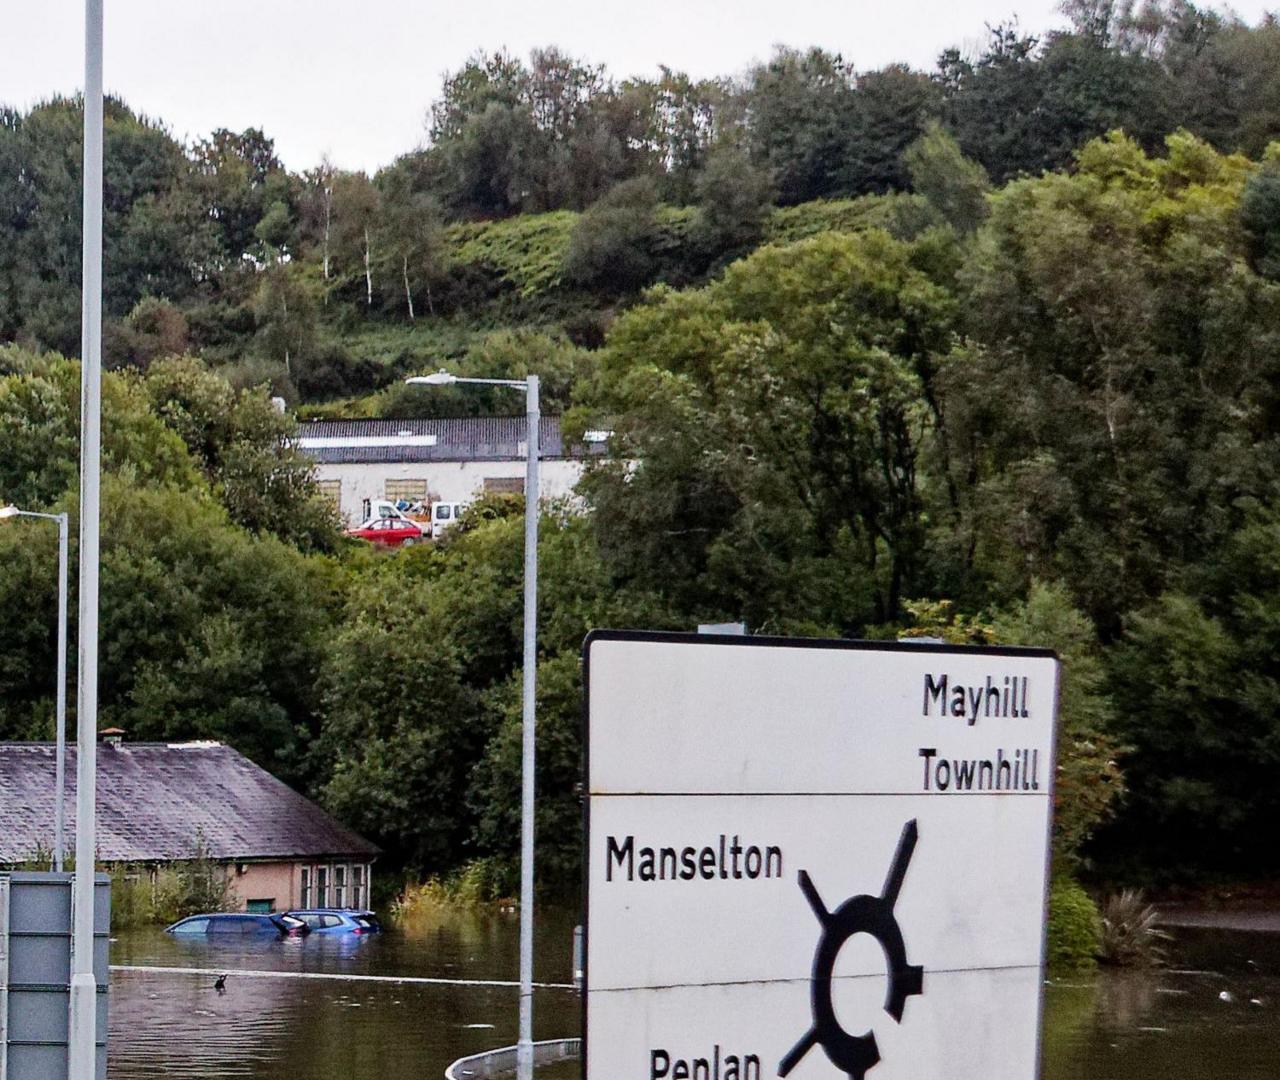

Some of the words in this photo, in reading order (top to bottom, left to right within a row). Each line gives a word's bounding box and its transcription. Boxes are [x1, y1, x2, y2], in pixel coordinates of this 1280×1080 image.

[923, 674, 1028, 726] Mayhill
[919, 748, 1038, 791] Townhill
[606, 835, 782, 882] Manselton
